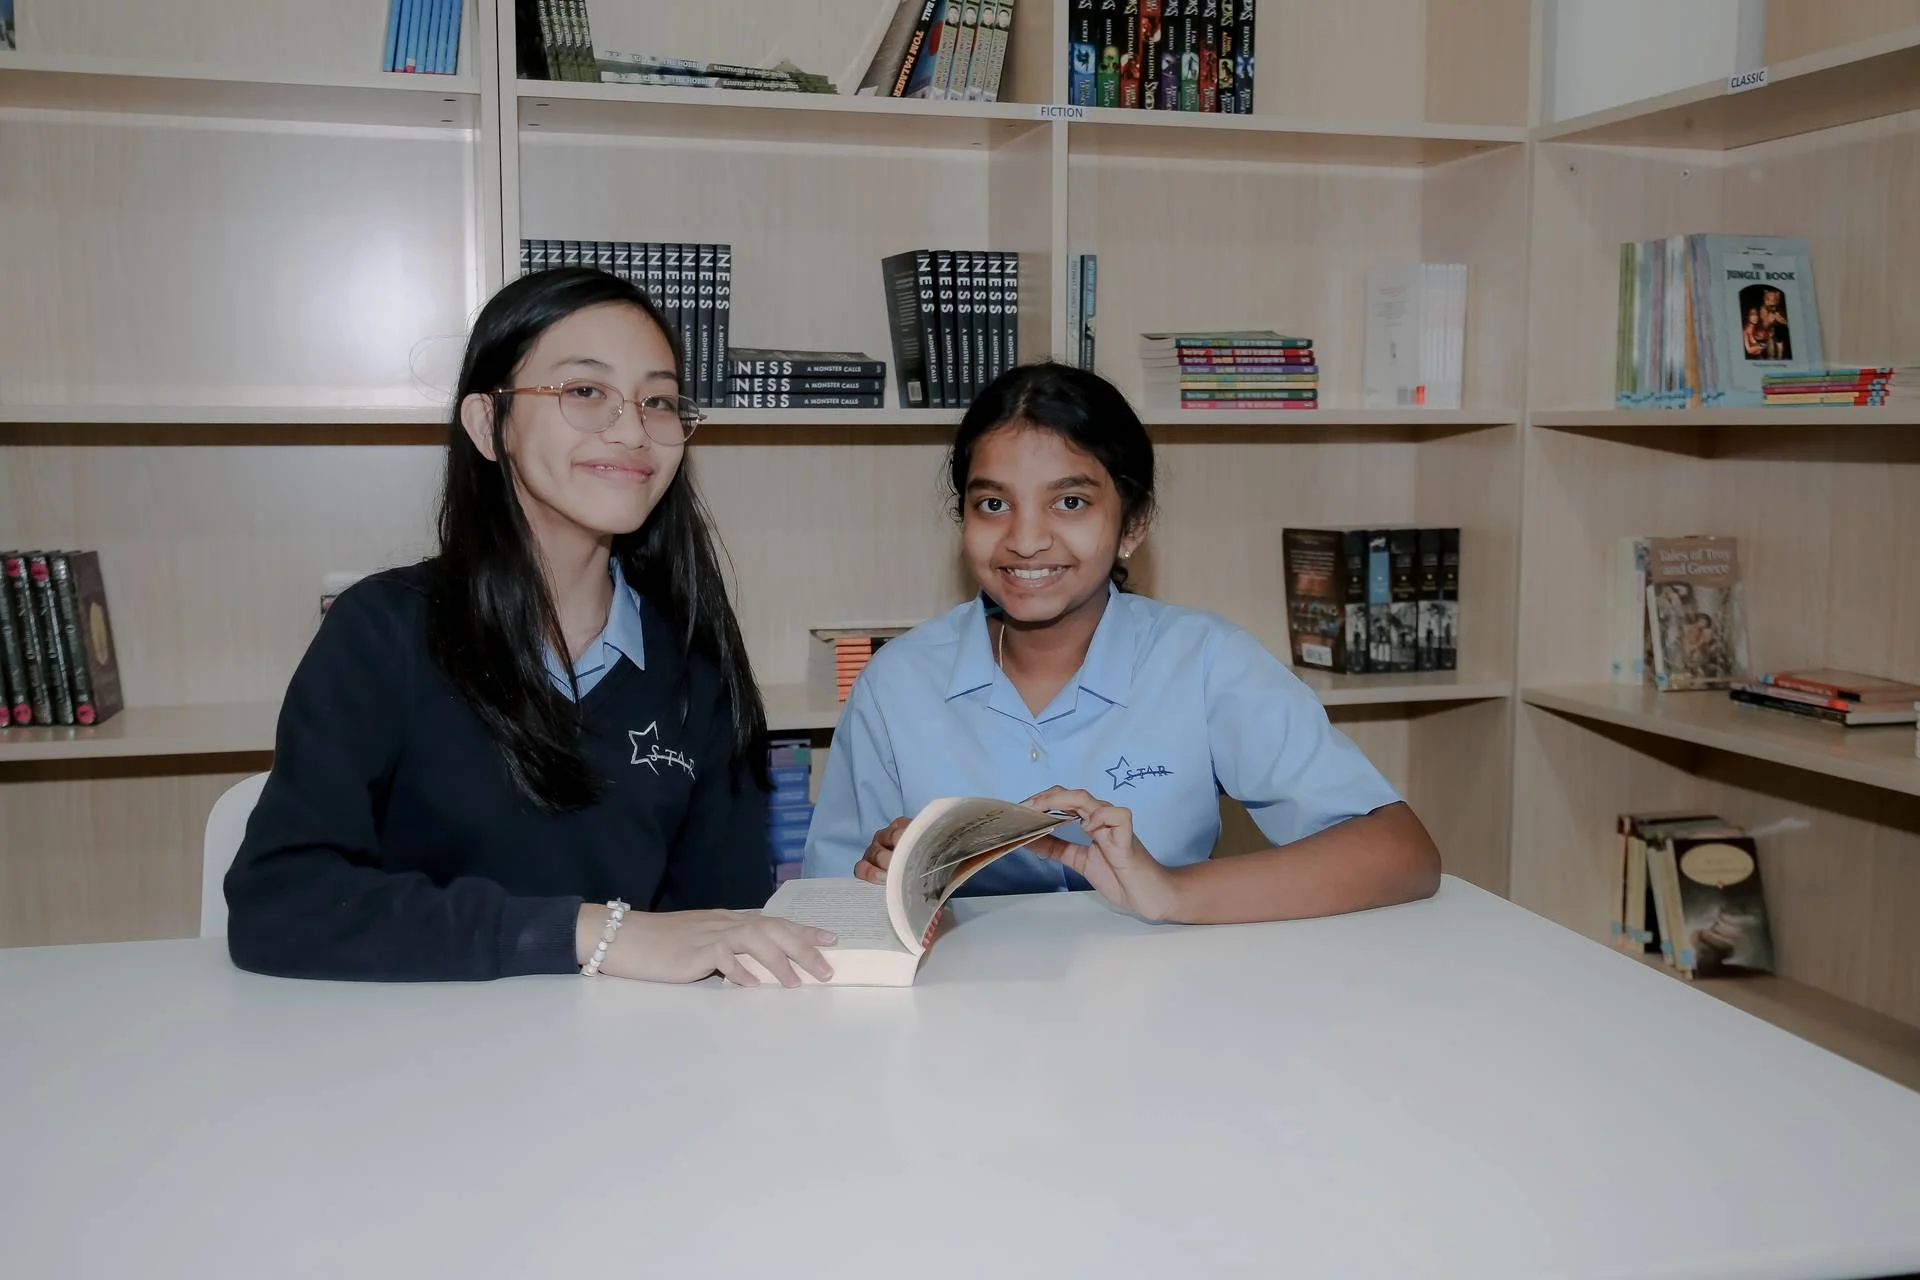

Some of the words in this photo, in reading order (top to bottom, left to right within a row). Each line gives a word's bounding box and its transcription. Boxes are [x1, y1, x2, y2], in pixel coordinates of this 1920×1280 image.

[921, 1, 935, 21] BALL
[909, 30, 925, 56] TOM
[893, 54, 916, 97] PALMER
[1731, 71, 1765, 88] CLASSIC
[1041, 106, 1083, 118] FICTION
[648, 252, 662, 308] NESS
[666, 252, 680, 308] NESS
[681, 252, 696, 308] NESS
[699, 253, 714, 309] NESS
[716, 254, 731, 310] NESS
[917, 258, 935, 312] NESS
[938, 259, 954, 313] NESS
[956, 259, 971, 313] NESS
[972, 260, 987, 314] NESS
[988, 260, 1002, 314] NESS
[1004, 261, 1018, 314] NESS
[1726, 270, 1760, 280] JUNGLE
[1765, 271, 1795, 280] BOOK
[736, 378, 790, 392] NESS
[738, 361, 792, 375] NESS
[735, 394, 789, 408] NESS
[647, 745, 695, 780] STAR
[1125, 765, 1172, 781] STAR
